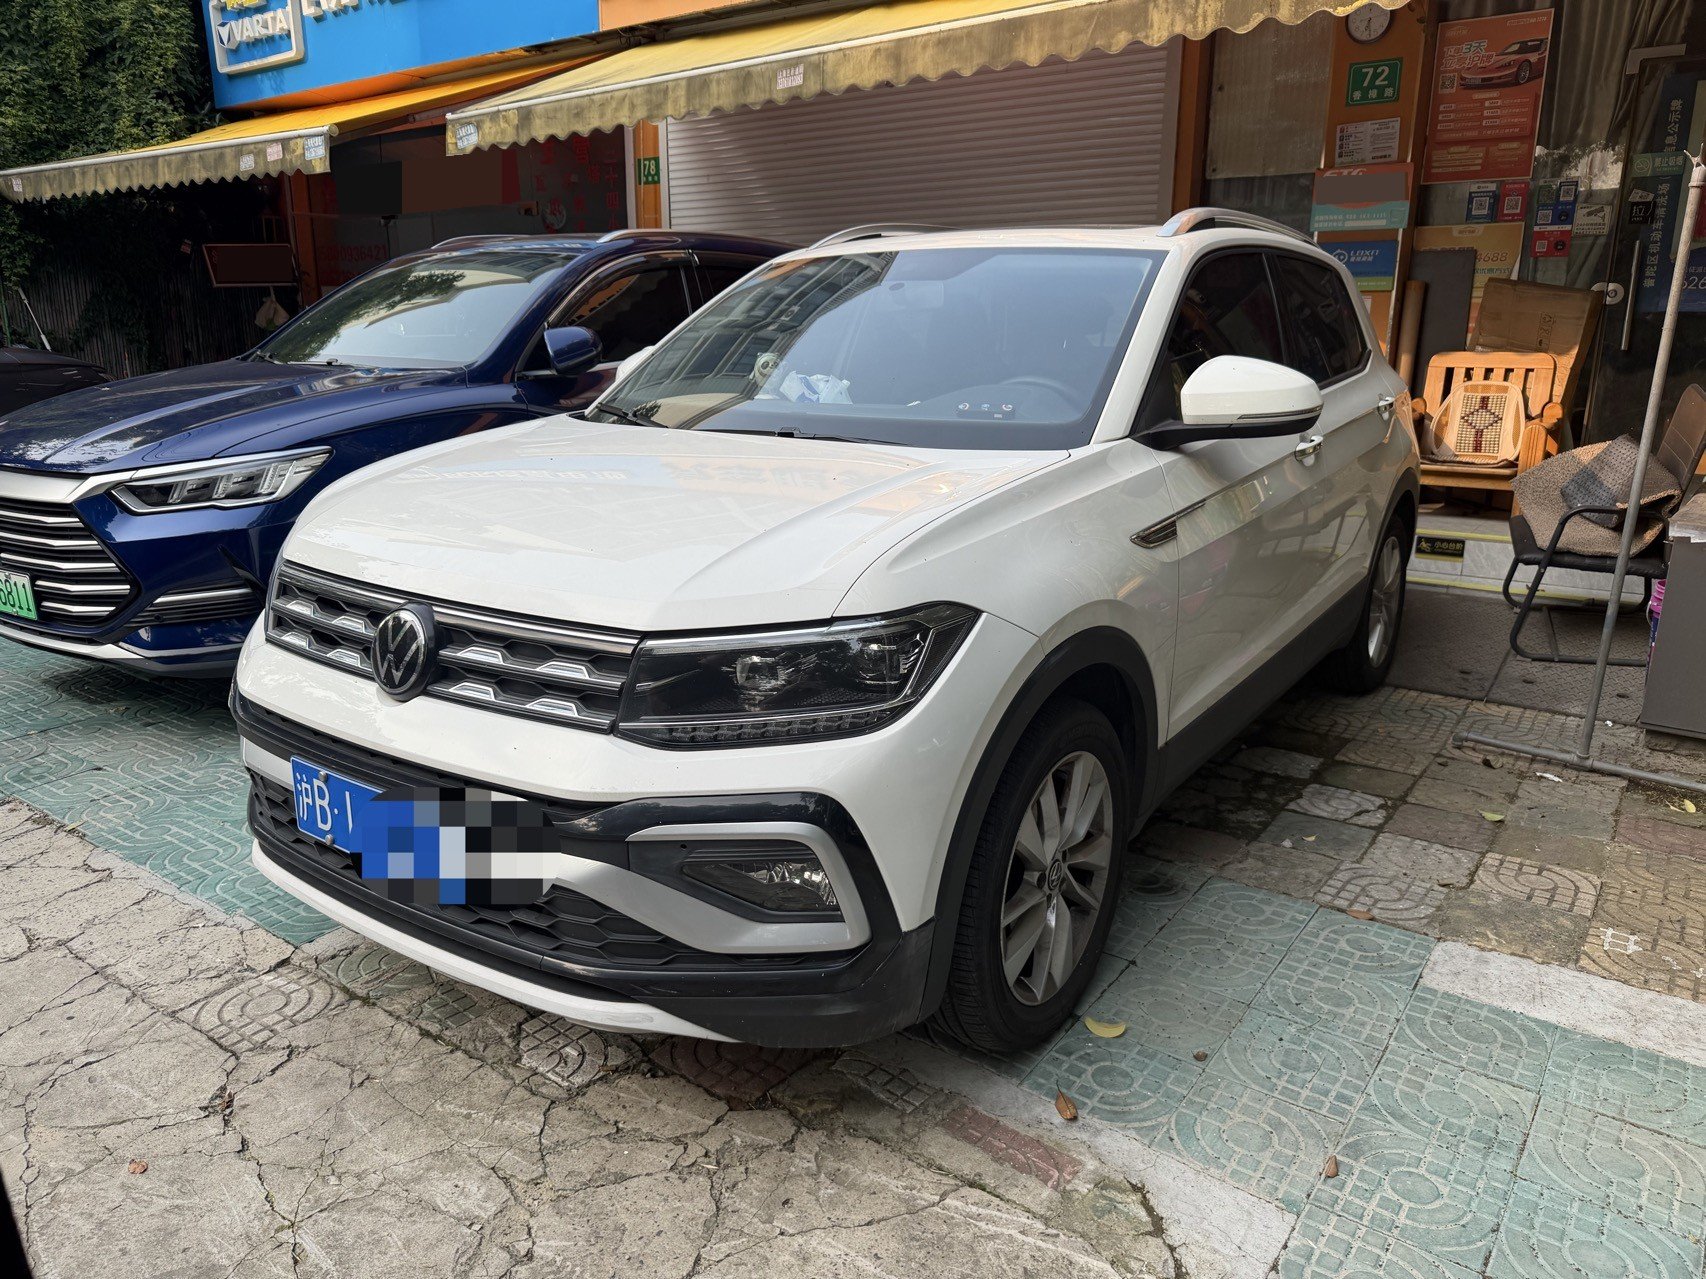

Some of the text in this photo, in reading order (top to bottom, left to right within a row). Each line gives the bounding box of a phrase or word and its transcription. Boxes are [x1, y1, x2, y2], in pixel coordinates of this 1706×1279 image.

[230, 8, 290, 41] VARTA
[1362, 65, 1390, 87] 72
[643, 159, 656, 176] 78
